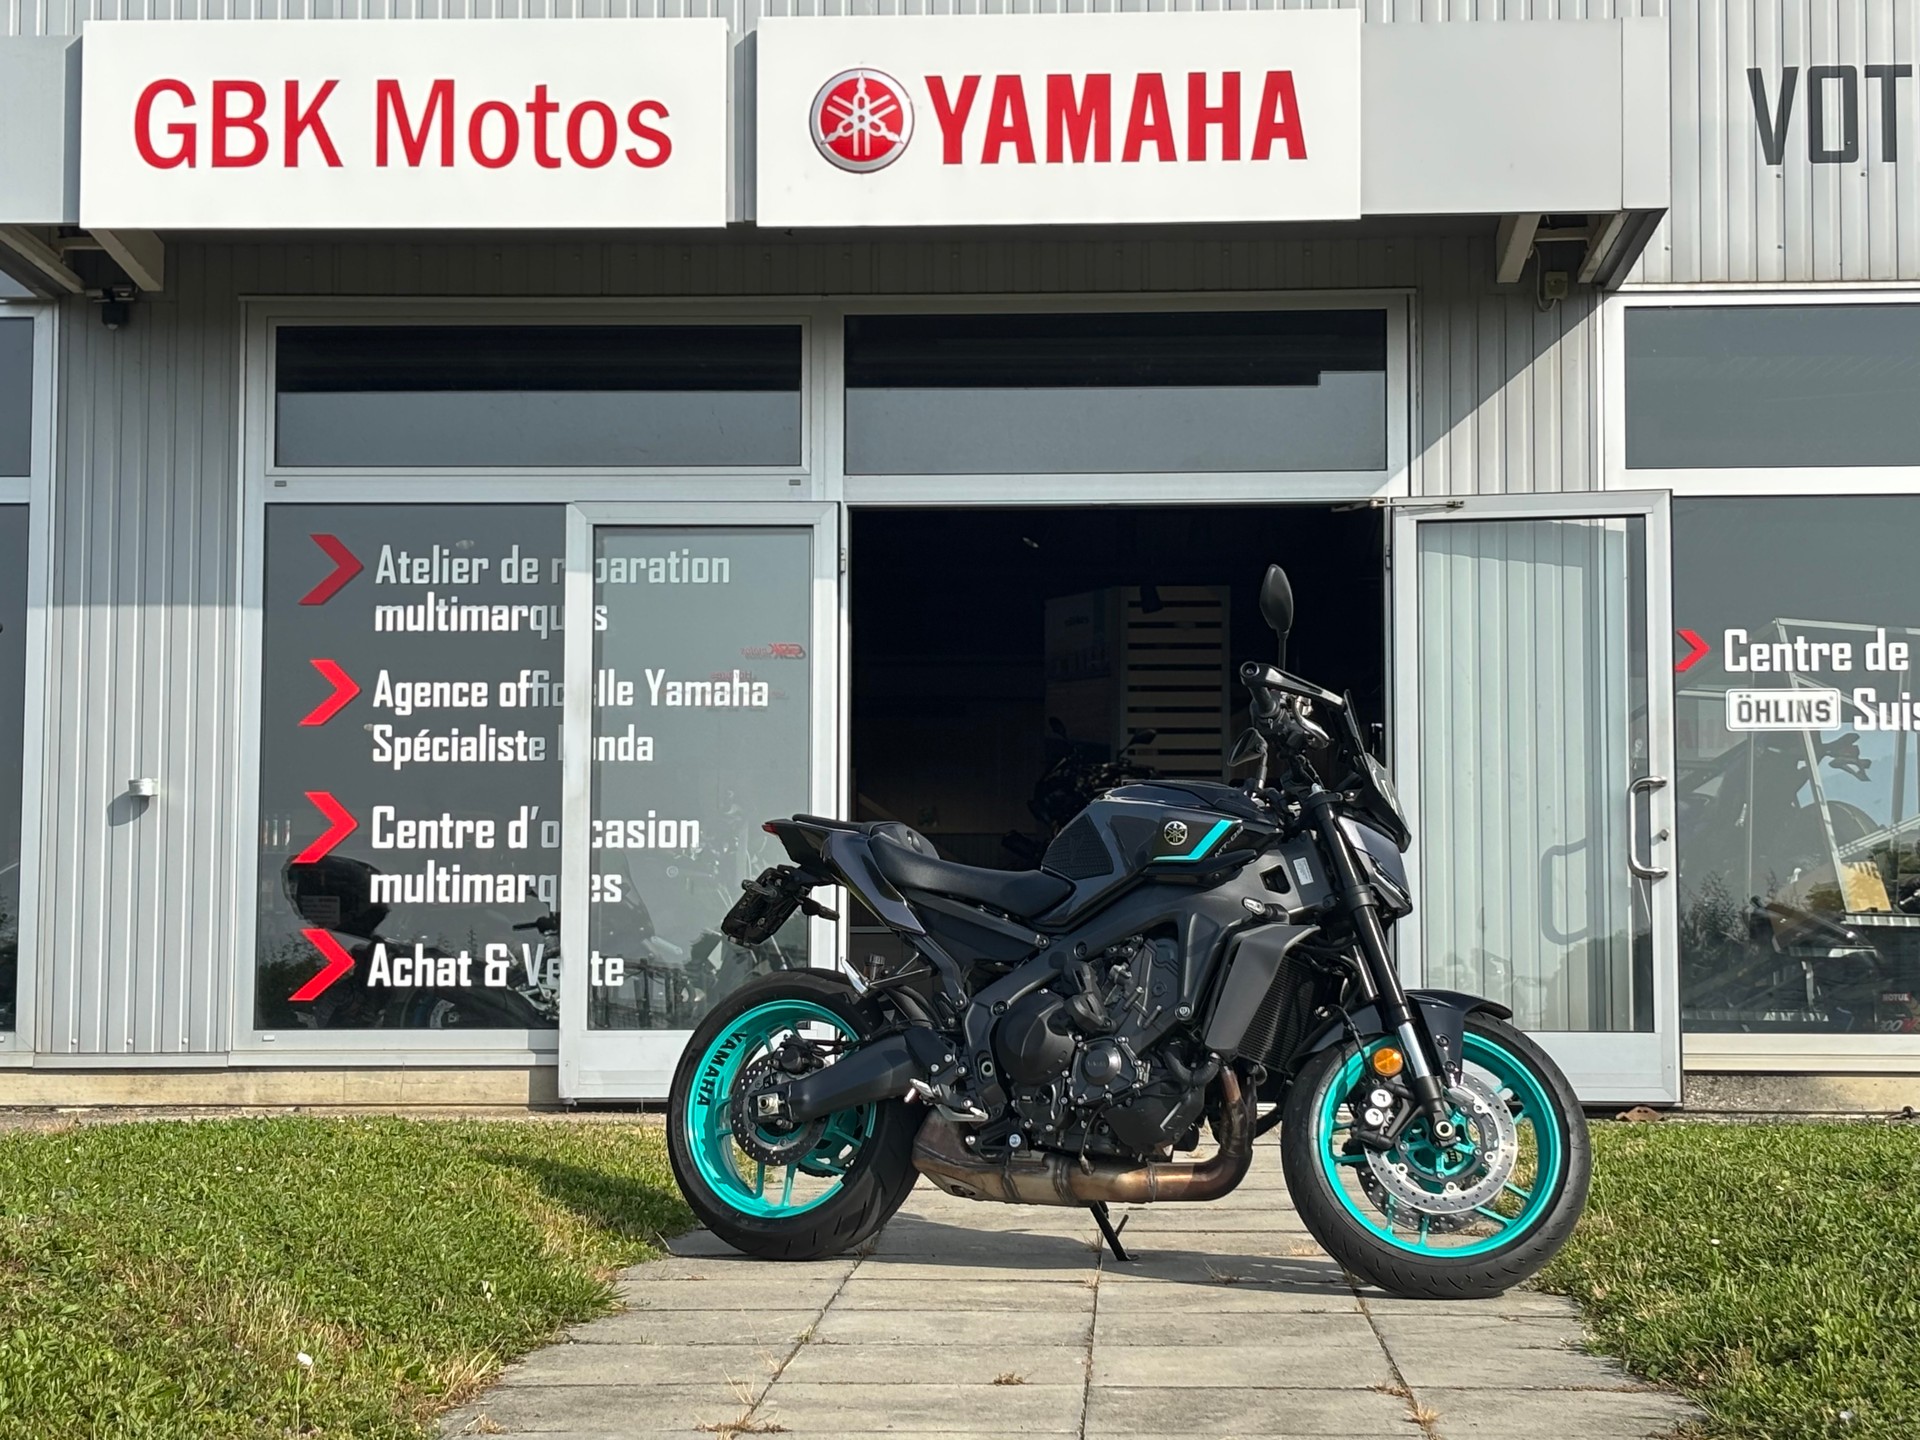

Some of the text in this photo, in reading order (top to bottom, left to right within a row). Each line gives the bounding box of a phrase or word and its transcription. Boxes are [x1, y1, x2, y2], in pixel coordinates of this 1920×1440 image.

[134, 78, 673, 169] GBK Motos
[924, 70, 1308, 165] YAMAHA
[1746, 64, 1913, 166] VOT
[375, 544, 730, 584] Atelier de rparation
[374, 591, 608, 639] multimarqus
[1723, 627, 1910, 672] Centre de
[372, 669, 488, 716] Agence
[499, 668, 634, 707] officlle
[644, 668, 769, 707] Yamaha
[1736, 693, 1832, 724] ÖHLINS
[372, 724, 654, 771] Spécialiste nda
[371, 805, 700, 849] Centre d'ocasion
[370, 859, 623, 912] multimarqes
[367, 943, 625, 987] Achat & Vete
[696, 1031, 749, 1106] YAMAHA
